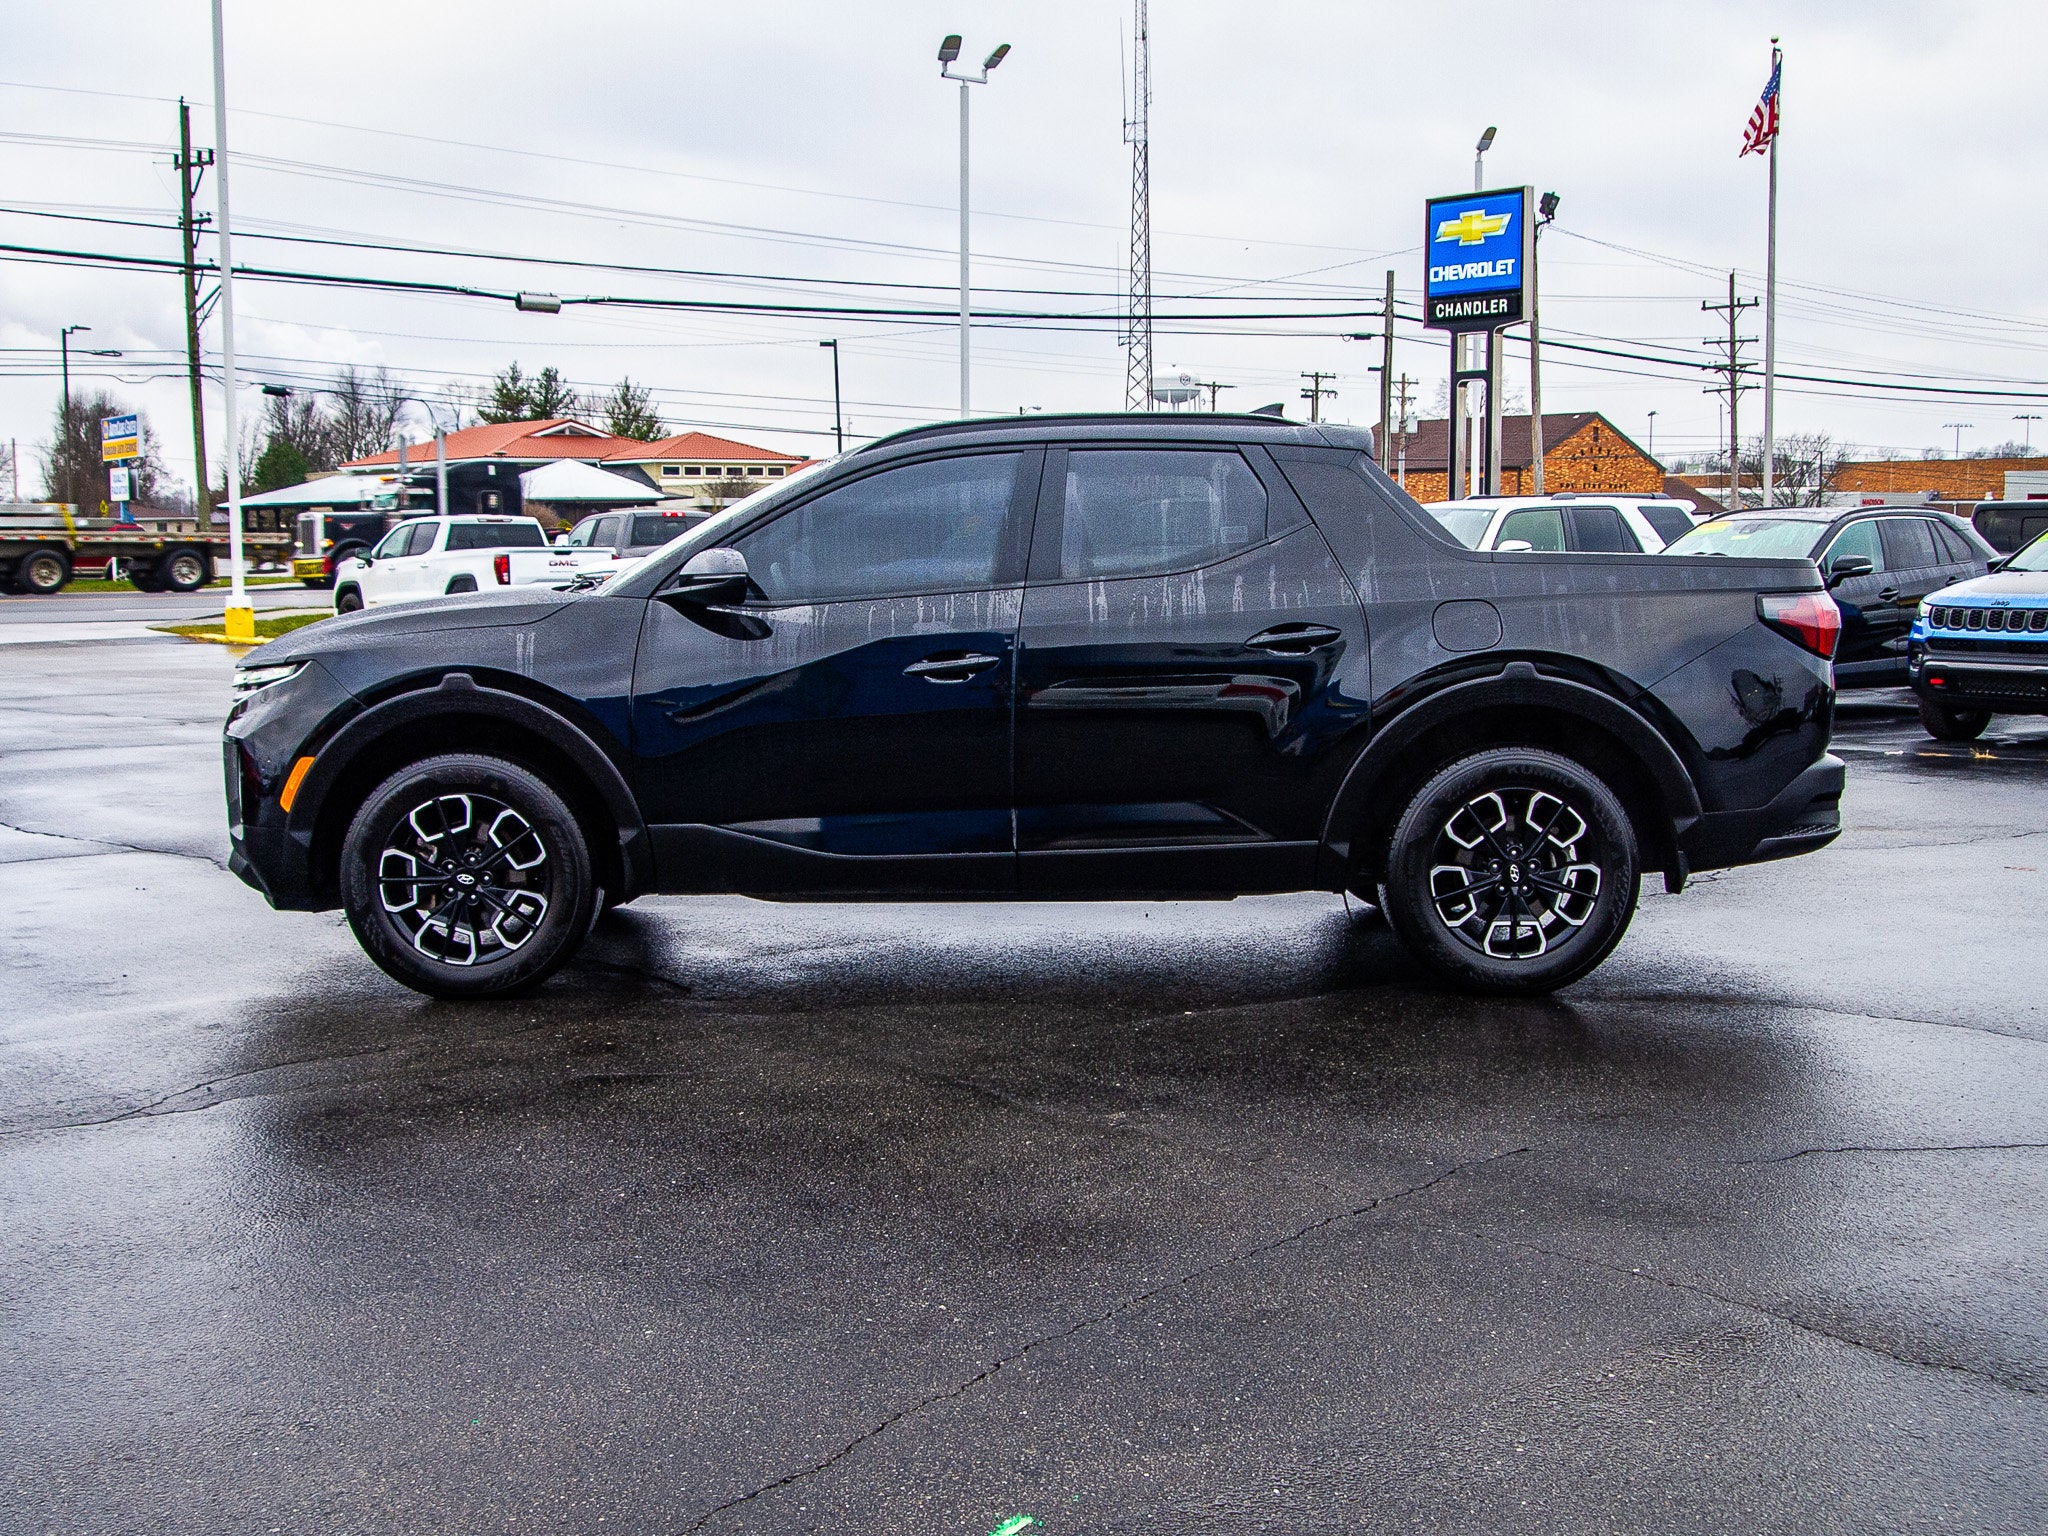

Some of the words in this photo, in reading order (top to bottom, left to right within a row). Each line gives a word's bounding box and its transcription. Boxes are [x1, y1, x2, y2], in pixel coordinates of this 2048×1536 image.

[1430, 258, 1515, 283] CHEVROLET
[1436, 298, 1508, 318] CHANDLER
[1991, 600, 2010, 608] Jeep
[1506, 764, 1576, 788] KUMHO
